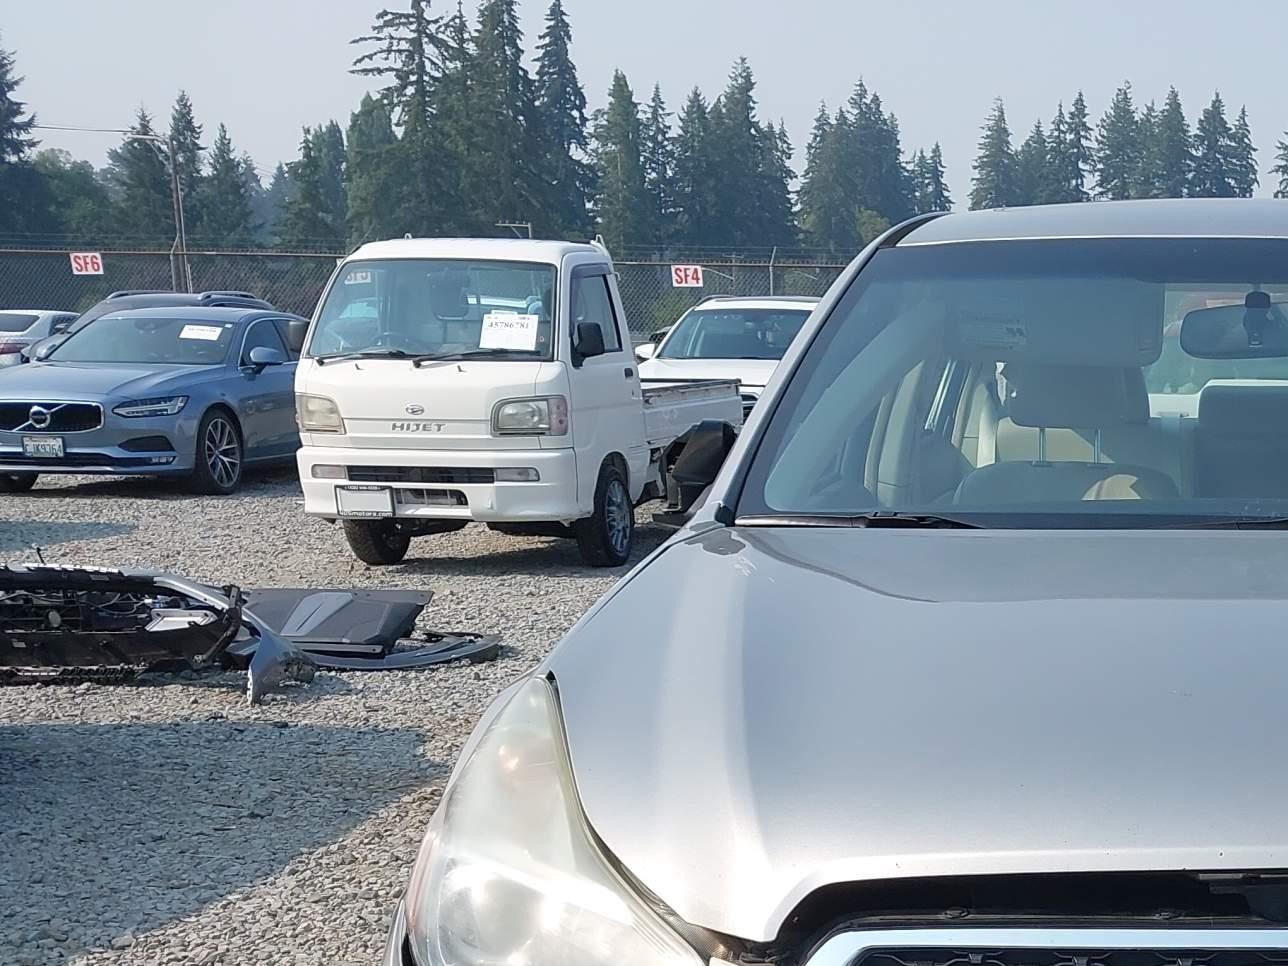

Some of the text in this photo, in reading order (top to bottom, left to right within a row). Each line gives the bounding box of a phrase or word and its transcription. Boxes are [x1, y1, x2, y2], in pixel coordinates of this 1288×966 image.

[73, 254, 100, 272] SF6
[674, 267, 700, 284] SF4
[391, 422, 446, 433] HIJET
